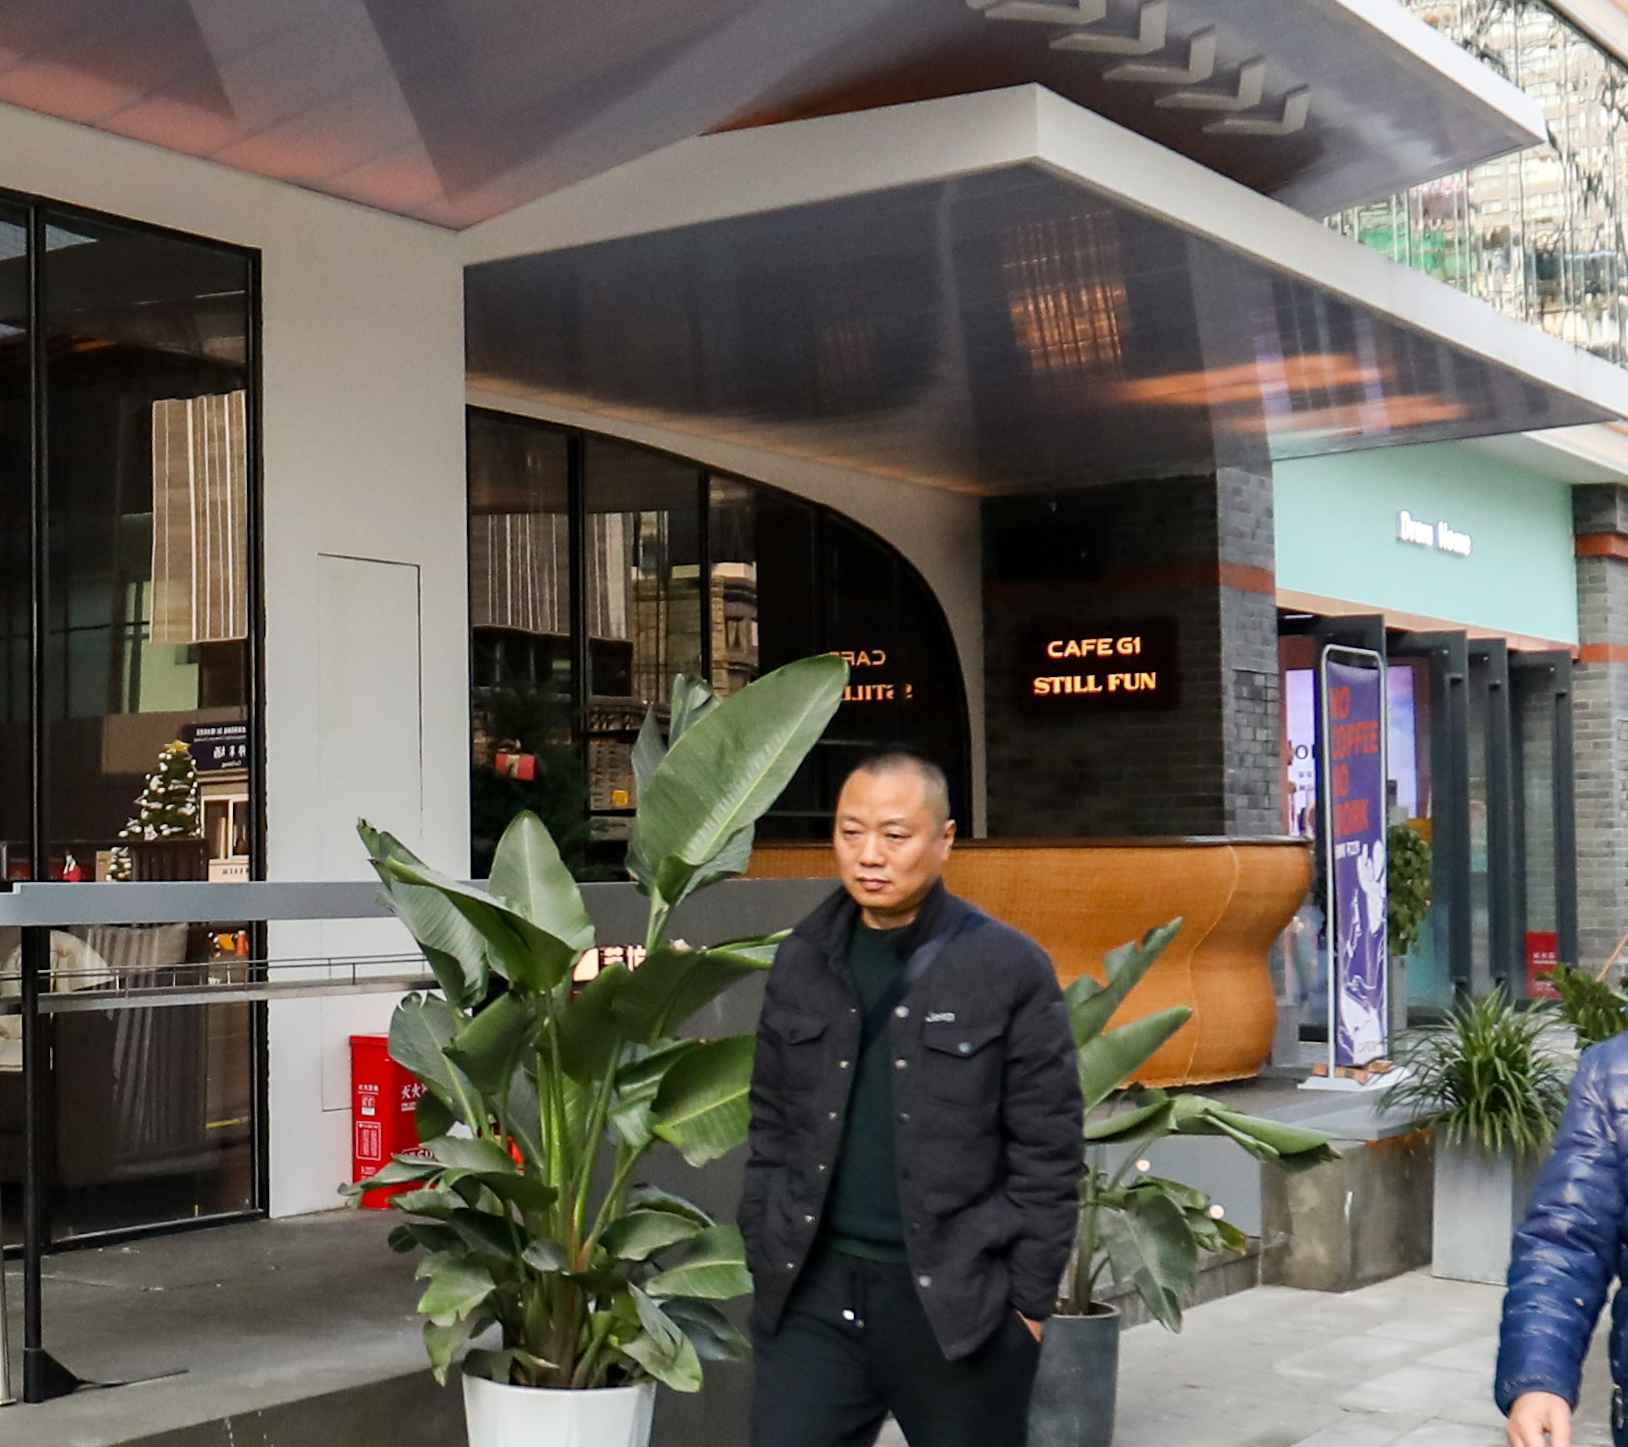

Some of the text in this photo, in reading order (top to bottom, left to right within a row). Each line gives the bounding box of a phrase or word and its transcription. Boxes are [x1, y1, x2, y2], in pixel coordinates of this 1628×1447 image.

[1047, 636, 1142, 659] CAFE G1
[1033, 671, 1157, 696] STILL FUN
[1331, 721, 1379, 760] COFFEE
